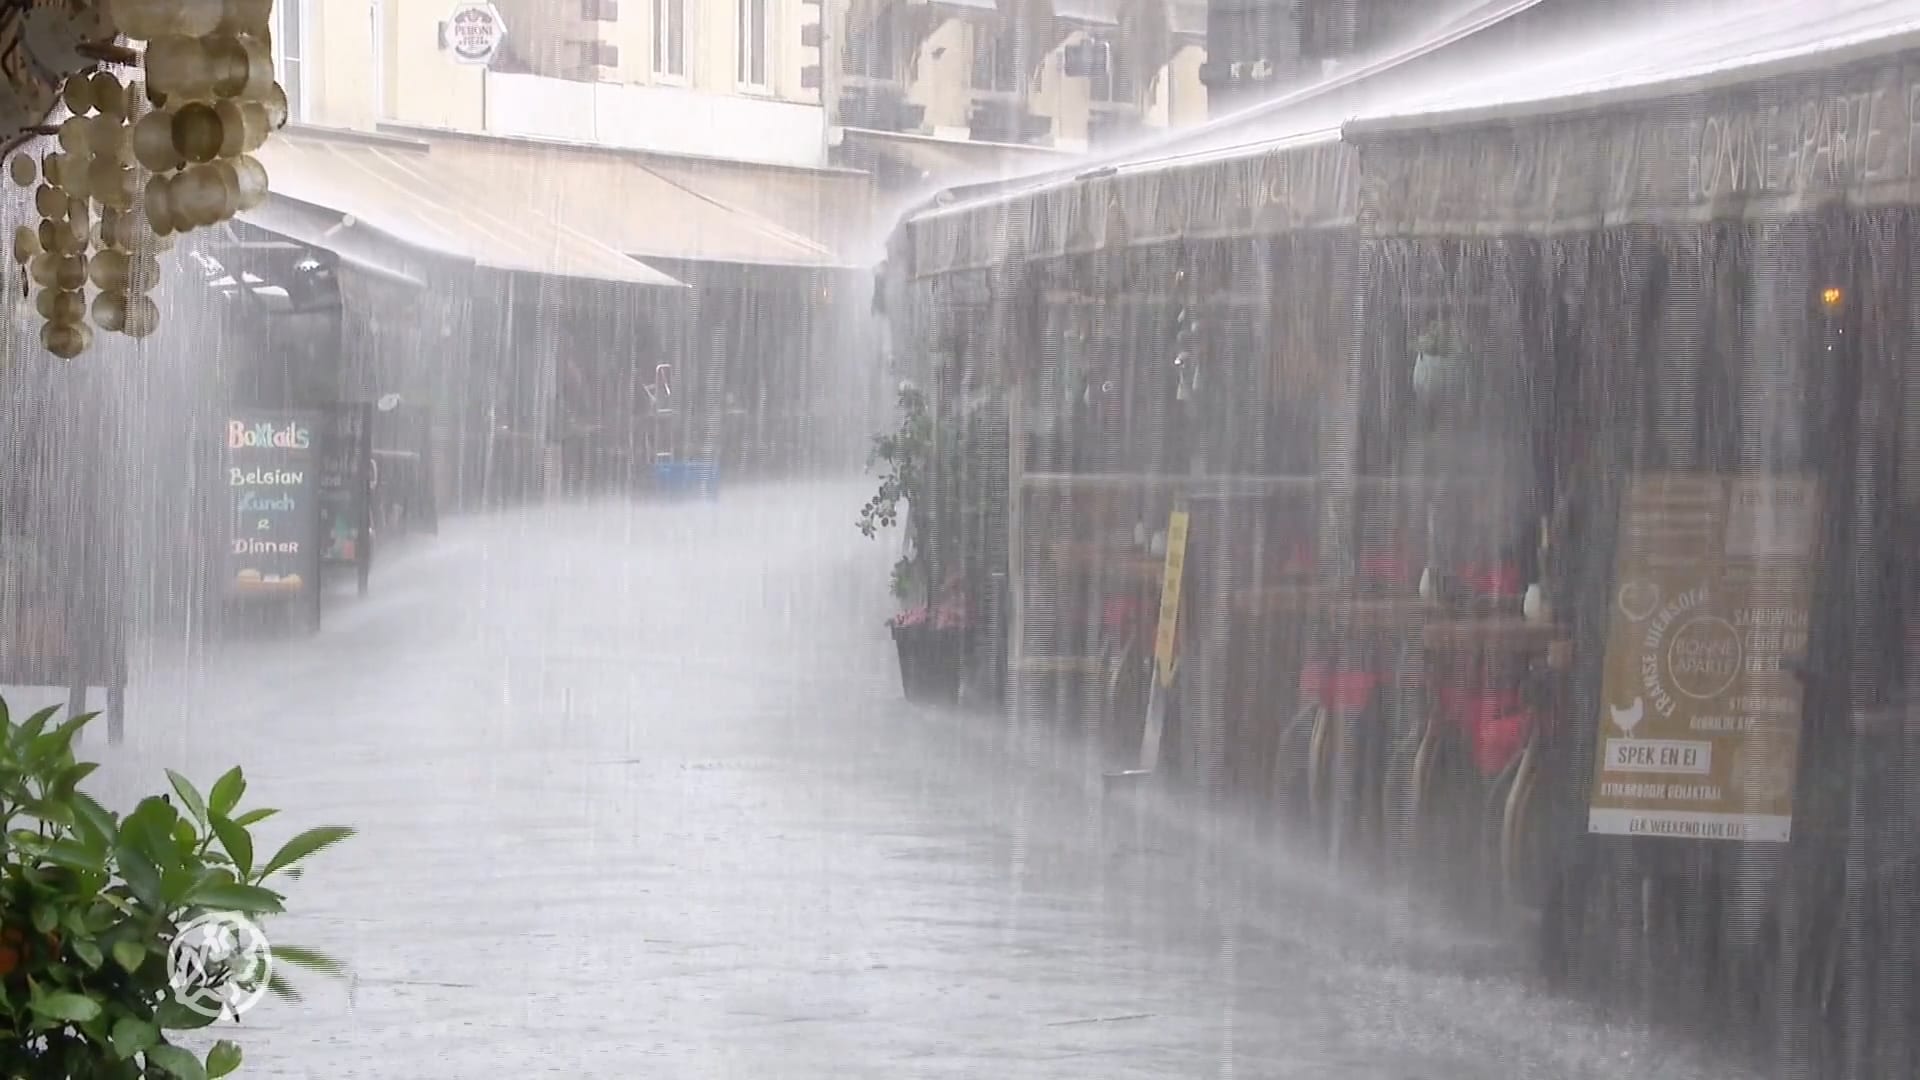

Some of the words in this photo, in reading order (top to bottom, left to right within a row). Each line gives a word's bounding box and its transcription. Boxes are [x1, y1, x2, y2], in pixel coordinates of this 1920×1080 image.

[1618, 747, 1655, 765] SPEK
[1660, 747, 1679, 766] EN
[1683, 748, 1697, 766] EI
[1650, 819, 1699, 835] WEEKEND
[1702, 821, 1725, 836] LIVE
